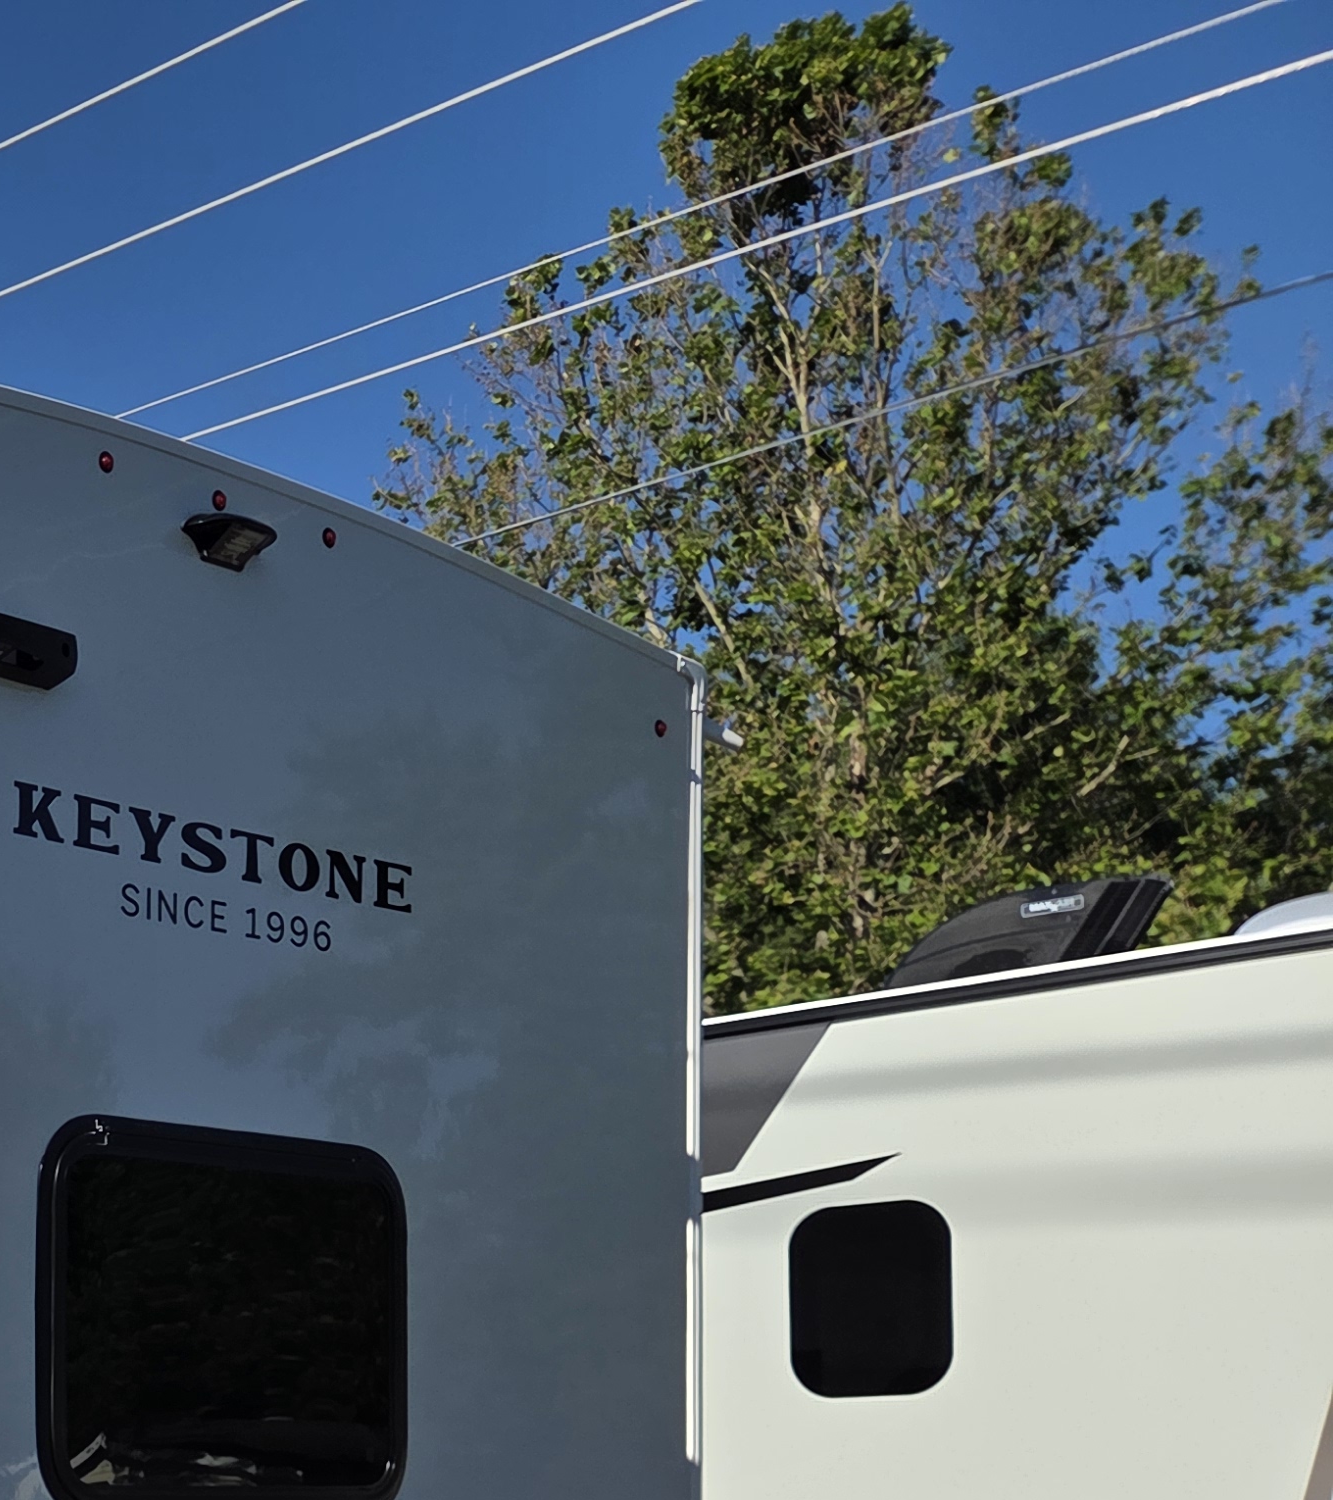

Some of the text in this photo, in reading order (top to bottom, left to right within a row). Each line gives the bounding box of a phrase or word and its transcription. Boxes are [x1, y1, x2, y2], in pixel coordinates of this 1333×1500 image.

[12, 779, 414, 914] KEYSTONE
[120, 882, 332, 952] SINCE 1996
